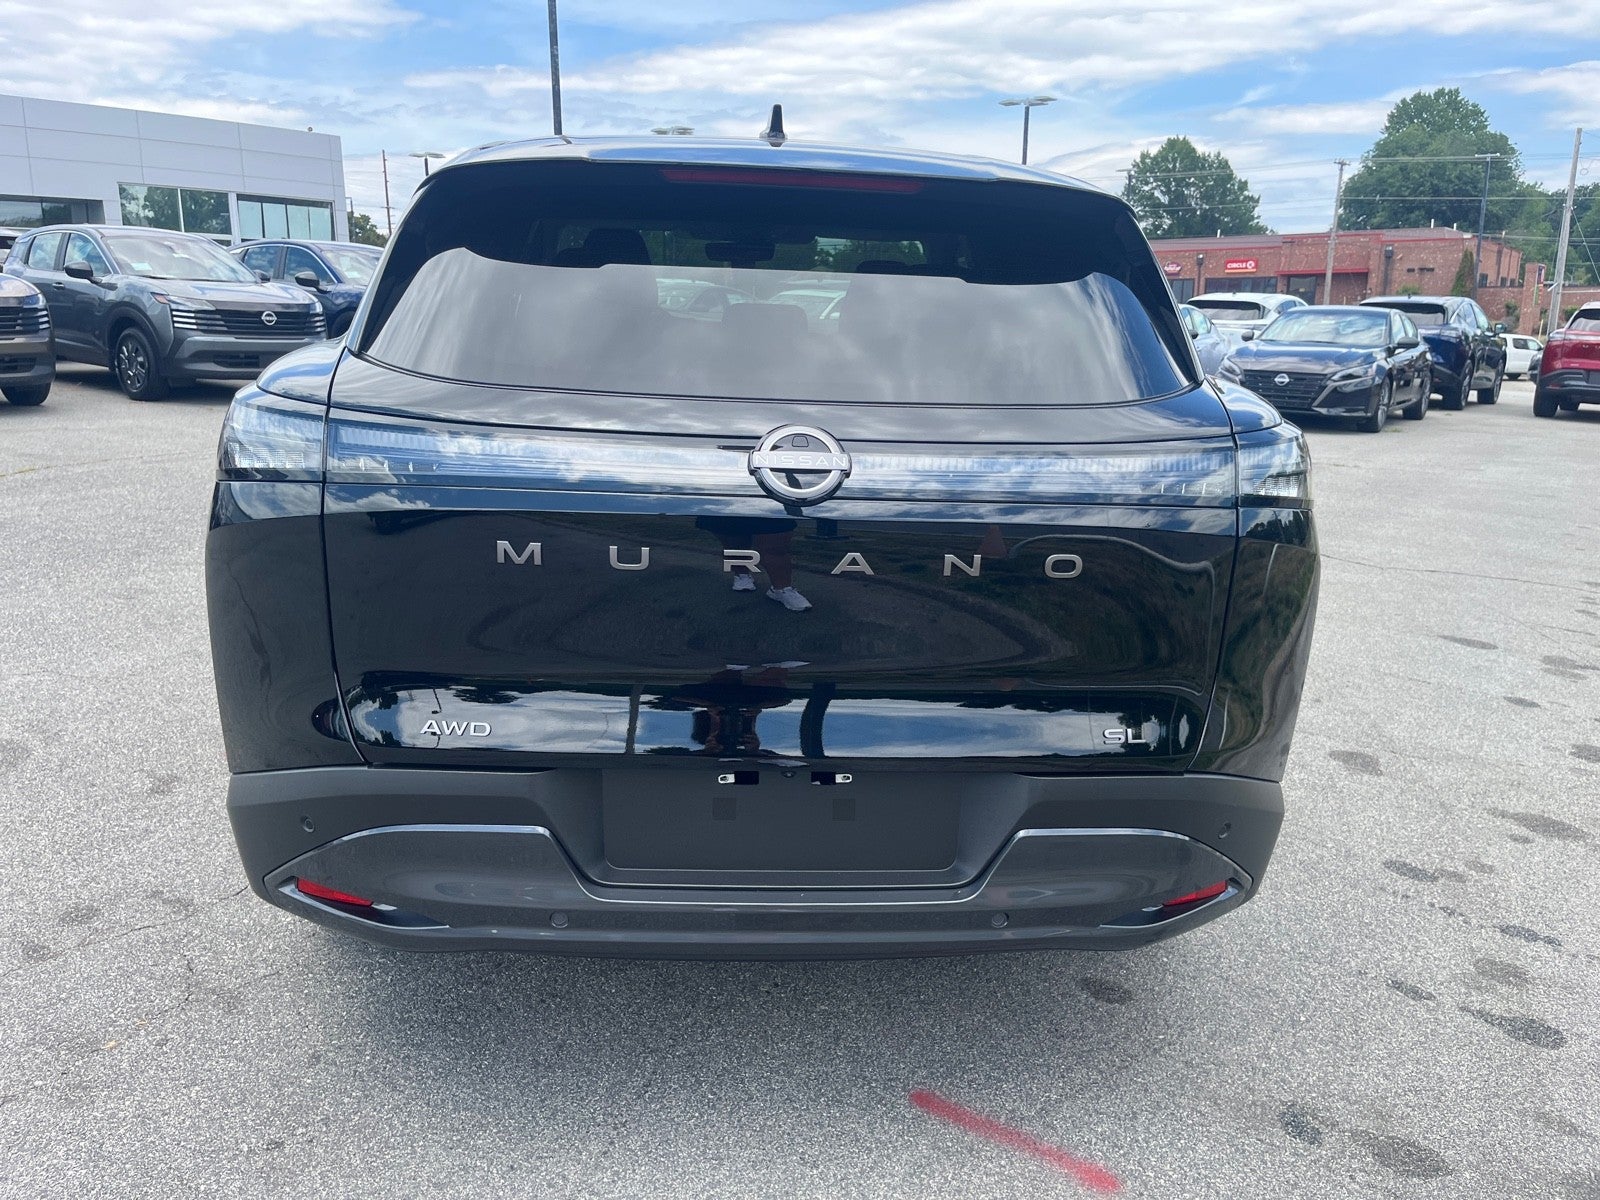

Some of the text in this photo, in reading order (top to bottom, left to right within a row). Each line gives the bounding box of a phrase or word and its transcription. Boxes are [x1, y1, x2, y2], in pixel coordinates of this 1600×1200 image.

[755, 454, 846, 467] NISSAN
[496, 540, 1083, 579] MURANO
[420, 719, 492, 737] AWD
[1103, 728, 1147, 744] SL
